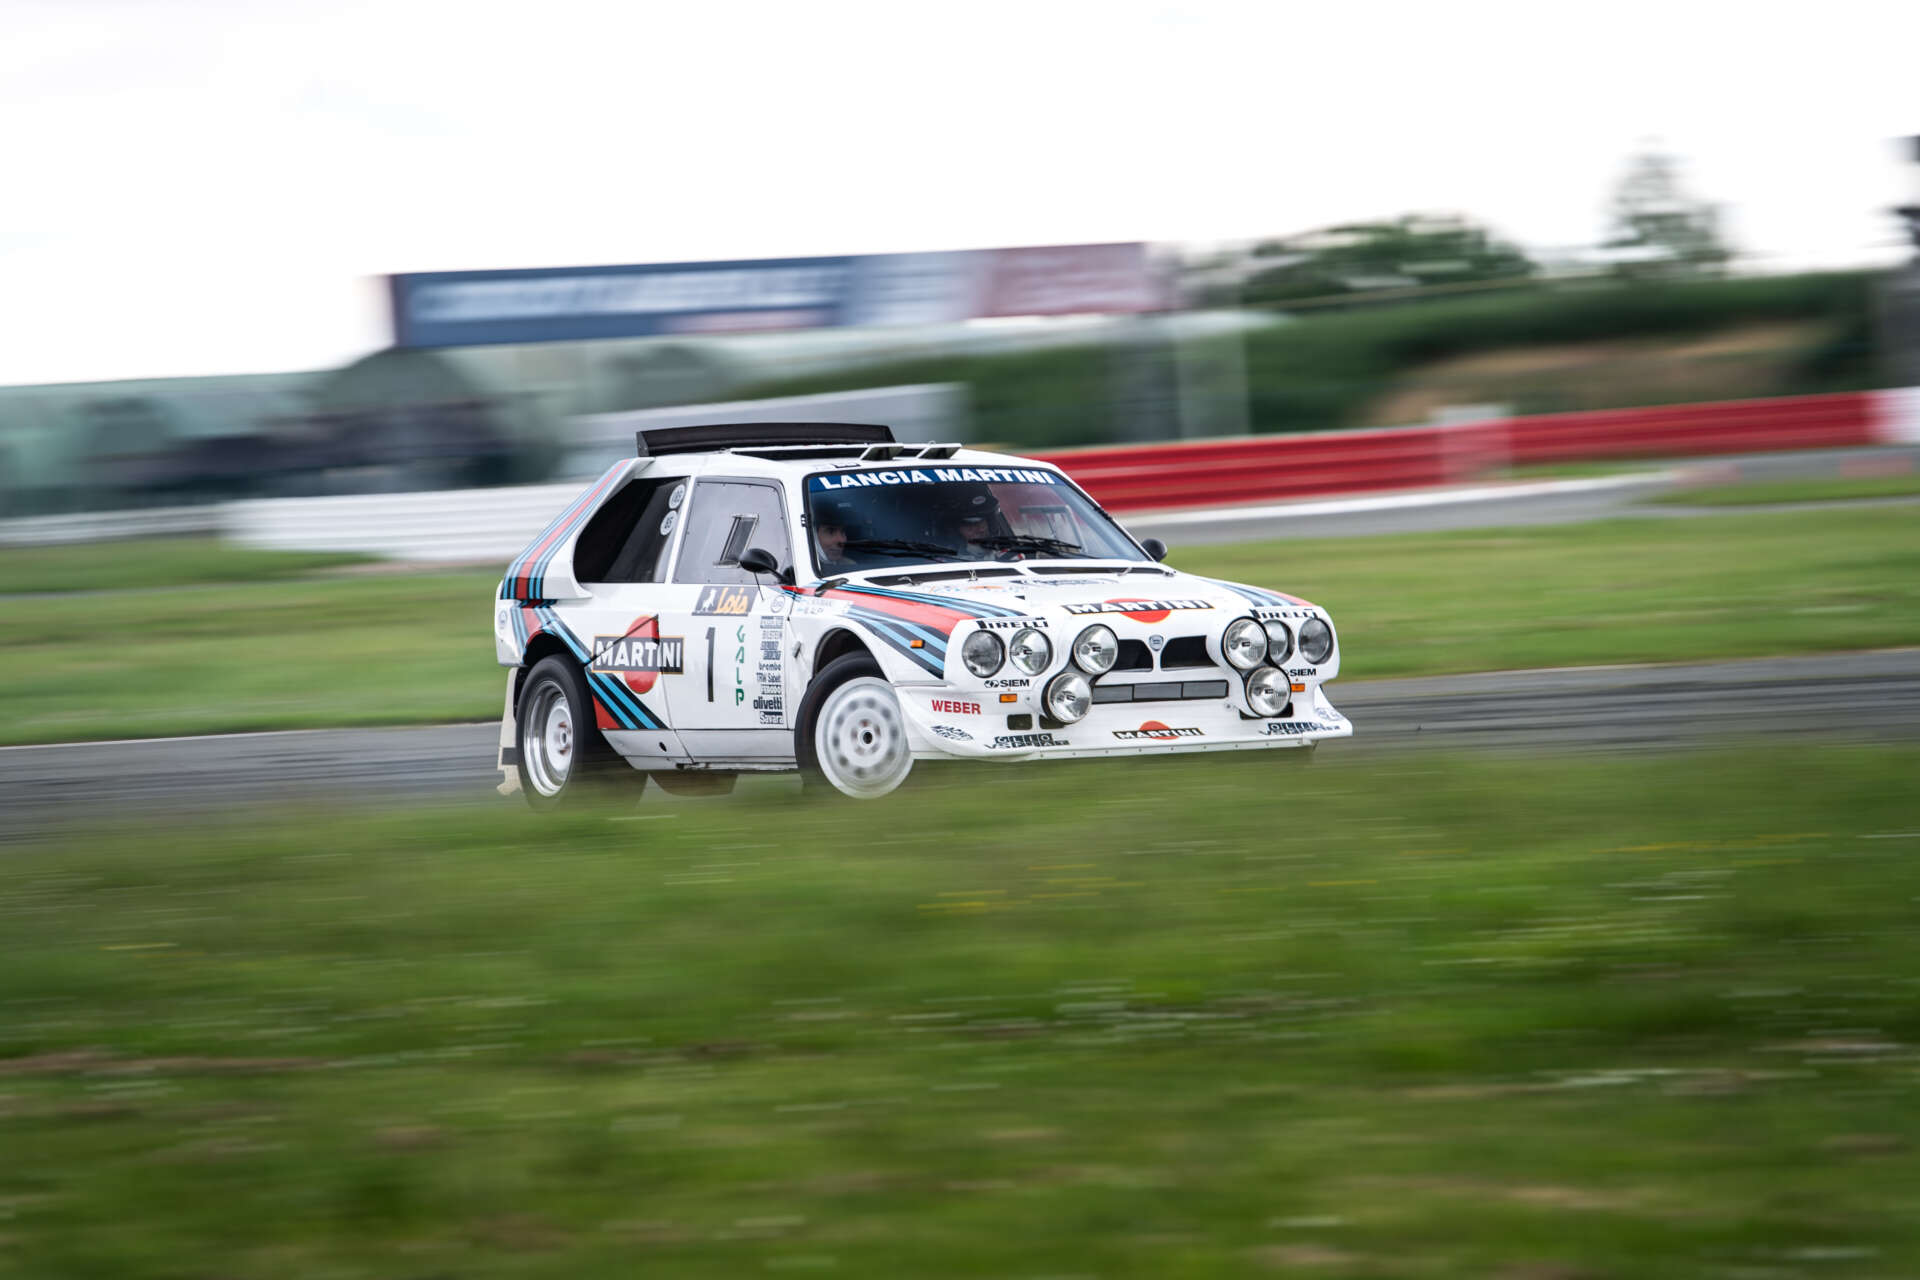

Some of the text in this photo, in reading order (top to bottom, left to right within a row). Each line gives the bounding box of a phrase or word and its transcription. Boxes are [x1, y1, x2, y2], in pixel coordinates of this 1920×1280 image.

[819, 468, 1056, 490] LANCIA MARTINI
[713, 586, 748, 614] Lois
[1069, 601, 1210, 614] MARTINI
[1249, 608, 1319, 619] PIRELLI
[976, 617, 1049, 629] PIRELLI
[596, 641, 681, 668] MARTINI
[705, 627, 716, 703] 1
[758, 661, 781, 670] brembo
[1289, 668, 1316, 677] SIEM
[1000, 679, 1029, 687] SIEM
[753, 696, 782, 709] olivetti
[931, 700, 981, 714] WEBER
[1116, 729, 1201, 739] MARTINI
